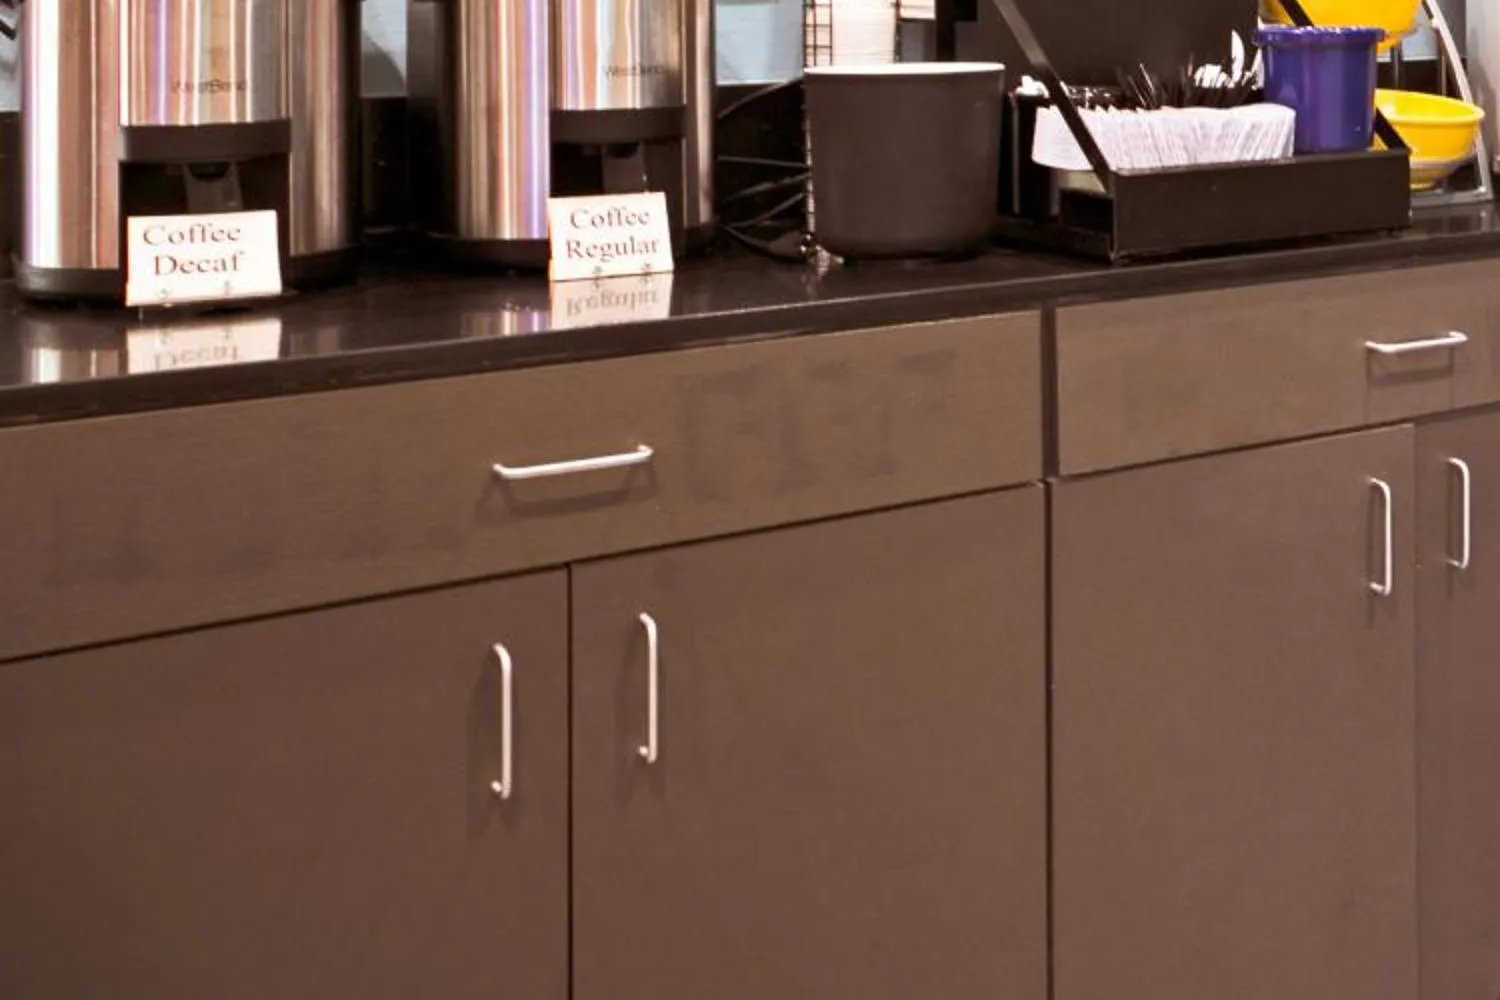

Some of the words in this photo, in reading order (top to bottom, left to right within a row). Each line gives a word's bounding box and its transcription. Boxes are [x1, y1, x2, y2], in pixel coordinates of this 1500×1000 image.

[570, 206, 650, 230] Coffee
[143, 222, 241, 246] Coffee
[566, 235, 659, 263] Regular
[154, 250, 246, 276] Decaf
